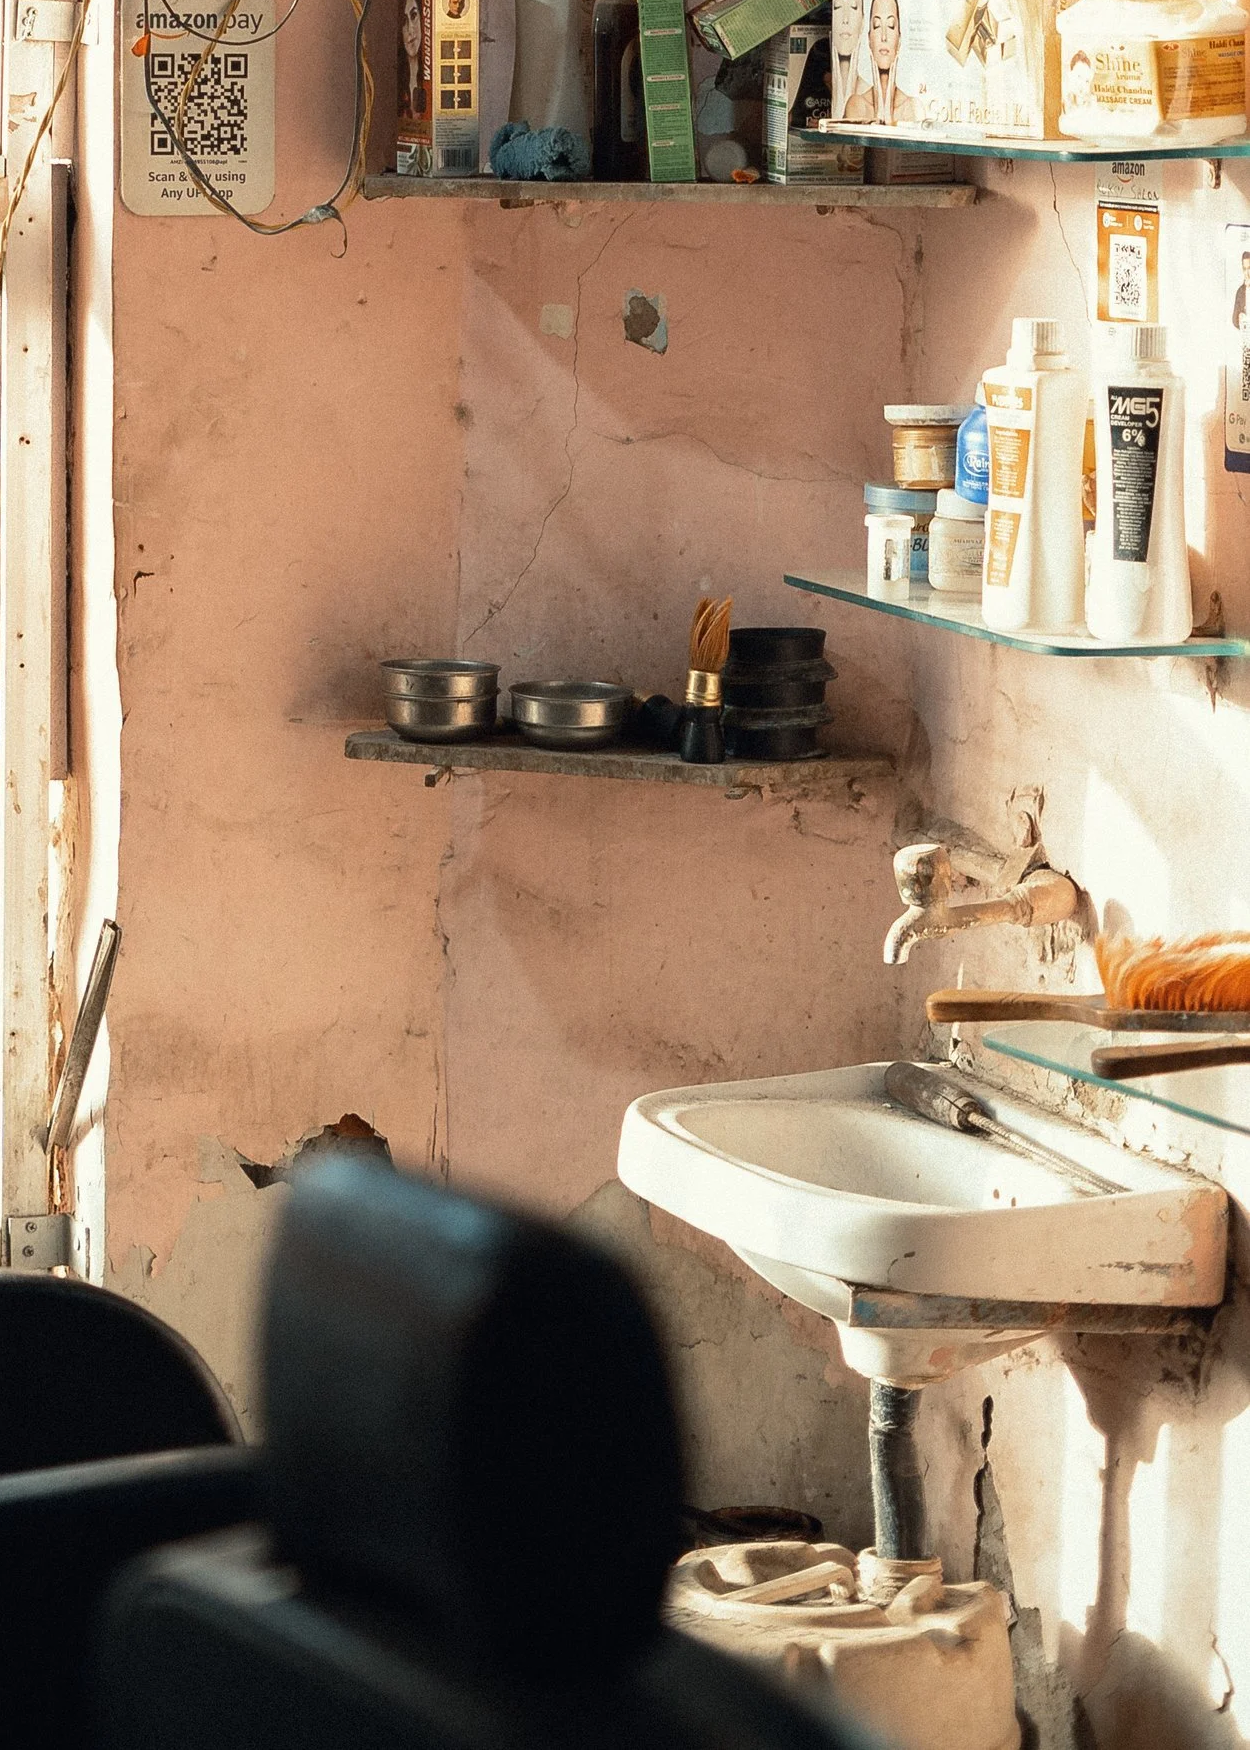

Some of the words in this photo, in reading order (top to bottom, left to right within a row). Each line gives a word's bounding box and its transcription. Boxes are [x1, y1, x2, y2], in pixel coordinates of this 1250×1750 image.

[136, 12, 218, 29] amazon
[223, 12, 264, 35] pay
[1208, 40, 1228, 50] Haldi
[1229, 38, 1246, 49] Chan
[1095, 53, 1141, 72] Shine
[918, 82, 928, 95] 24
[1093, 84, 1116, 95] Haldi
[1117, 85, 1153, 96] Chandan
[805, 96, 831, 107] GARN
[1096, 95, 1128, 104] MASSAGE
[1129, 96, 1152, 105] CREAM
[812, 108, 831, 119] Col
[928, 99, 963, 124] Gold
[1111, 160, 1145, 176] amazon
[148, 171, 176, 183] Scan
[178, 171, 188, 182] &
[215, 171, 246, 184] using
[161, 187, 183, 200] Any
[186, 188, 203, 198] UP
[1111, 397, 1160, 428] MG5
[1111, 420, 1143, 428] DEVELOPER
[1228, 413, 1235, 424] G
[1236, 414, 1247, 426] Pay
